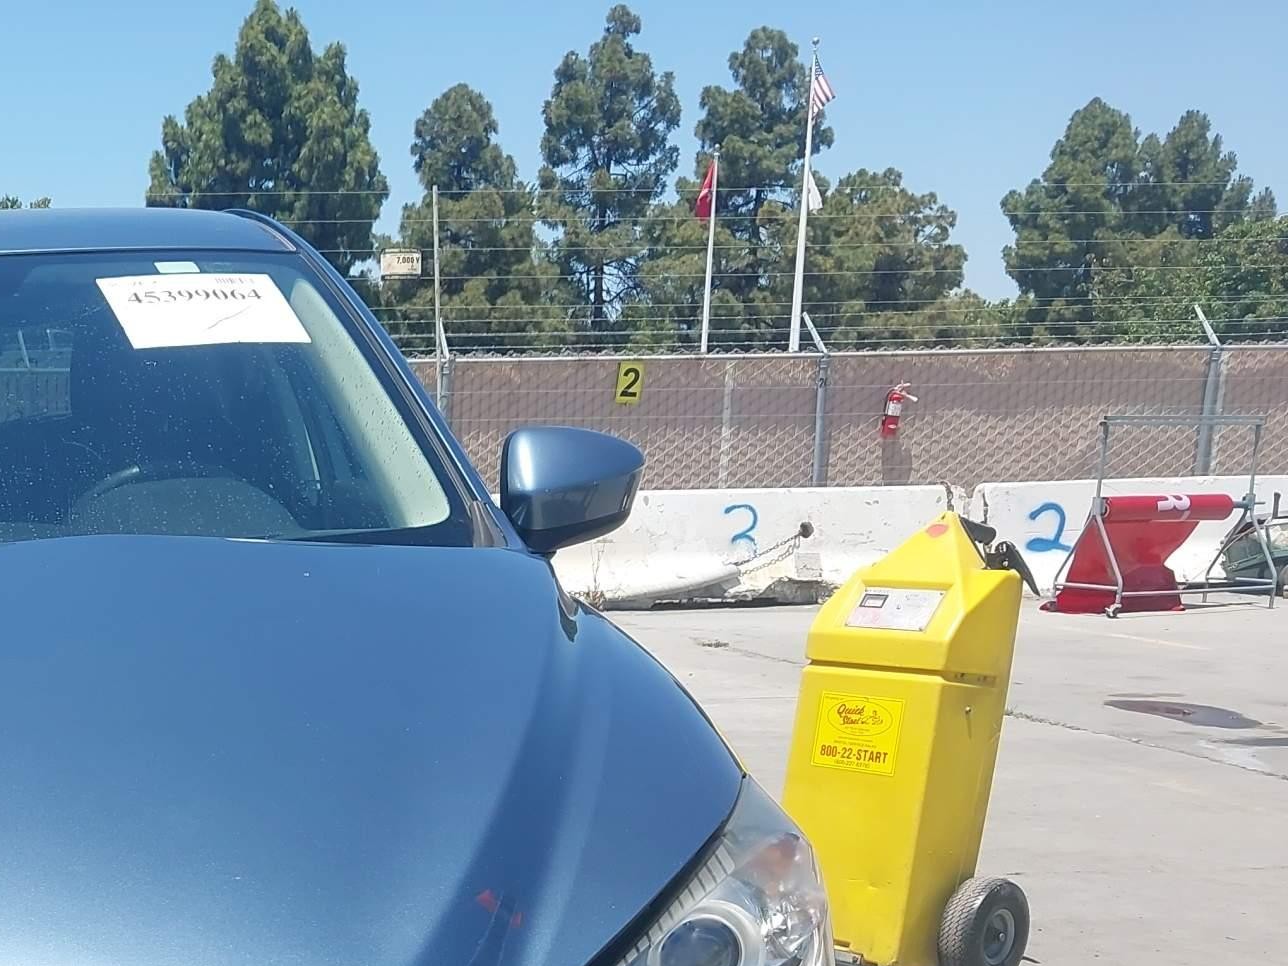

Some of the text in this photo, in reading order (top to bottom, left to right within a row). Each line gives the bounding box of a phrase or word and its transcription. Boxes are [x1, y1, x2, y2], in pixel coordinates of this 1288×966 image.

[127, 288, 262, 304] 45399064
[620, 367, 640, 398] 2
[1026, 502, 1071, 552] 2
[837, 703, 866, 718] Quick
[819, 744, 889, 764] 800-22-START
